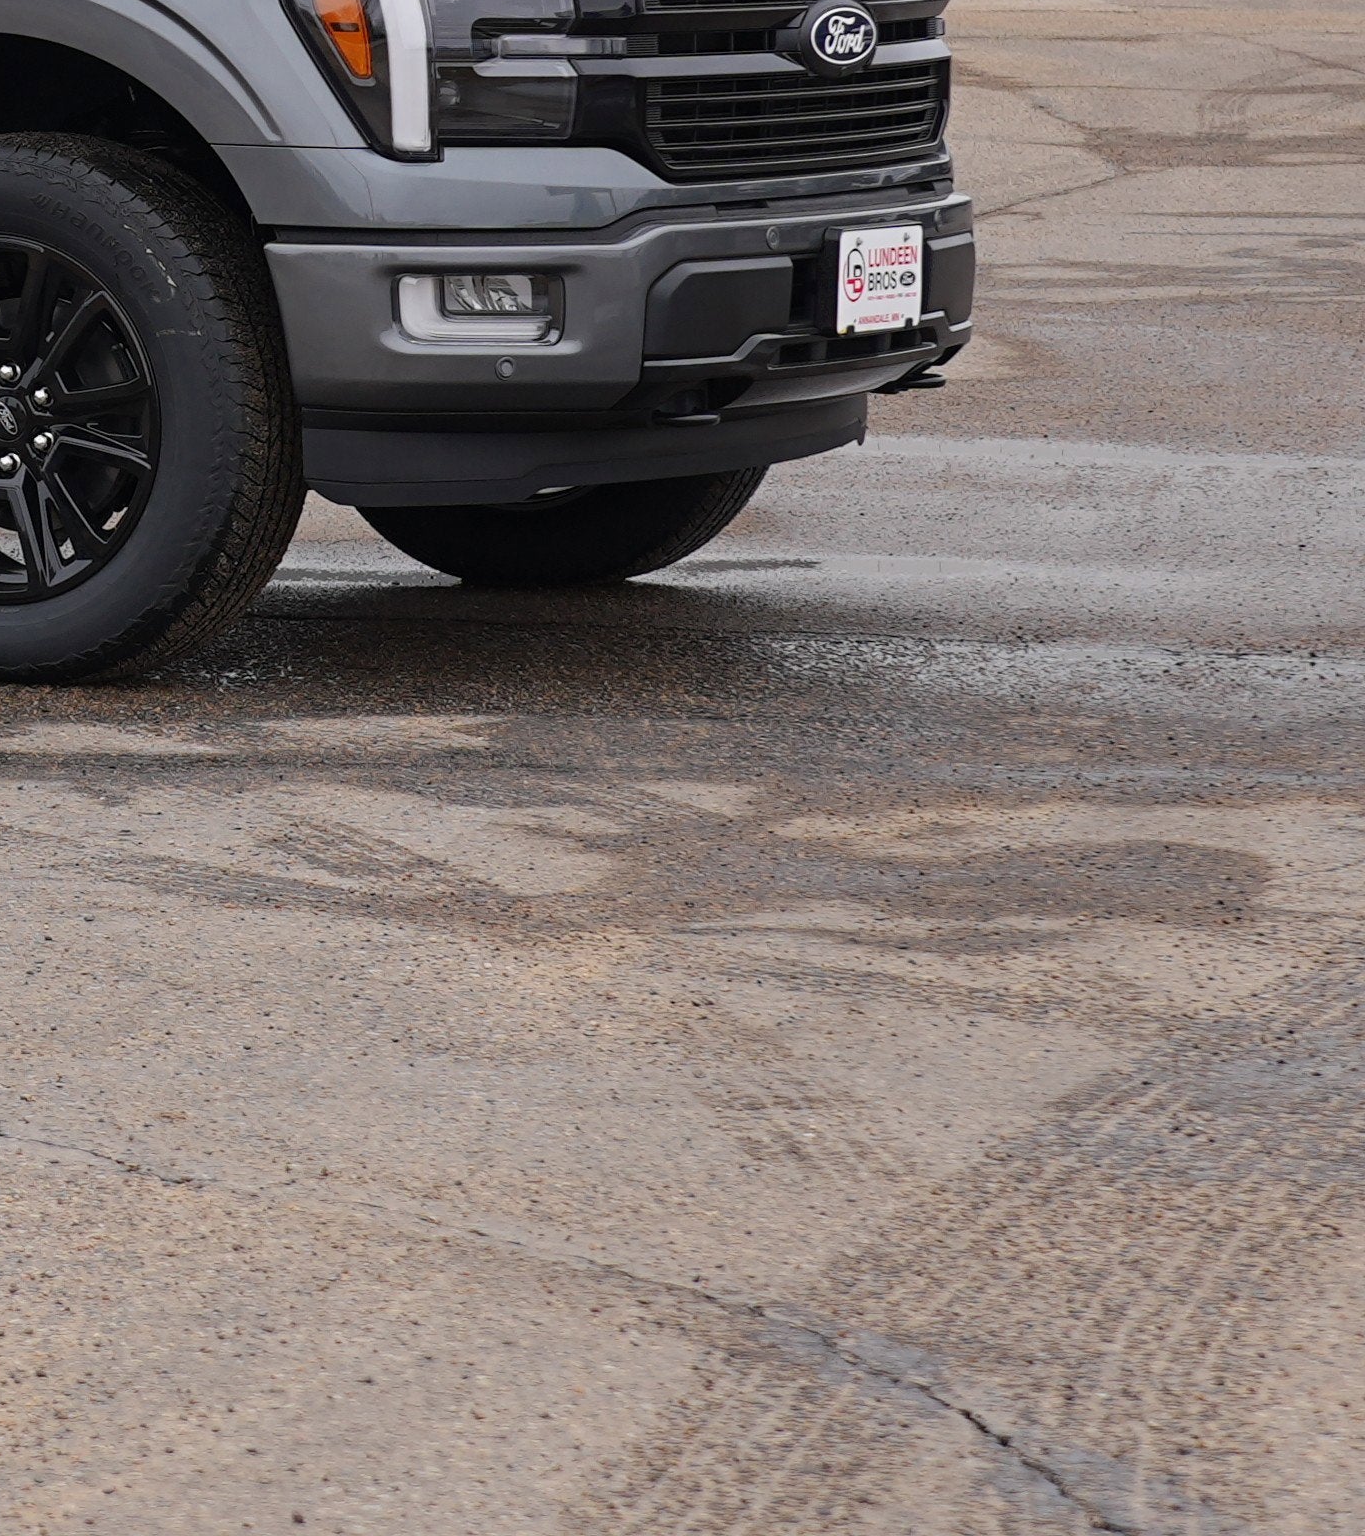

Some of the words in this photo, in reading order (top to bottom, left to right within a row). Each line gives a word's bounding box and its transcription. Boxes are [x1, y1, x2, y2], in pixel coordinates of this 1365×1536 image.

[825, 15, 867, 55] Ford
[868, 245, 919, 268] LUNDEEN
[868, 270, 898, 292] BROS
